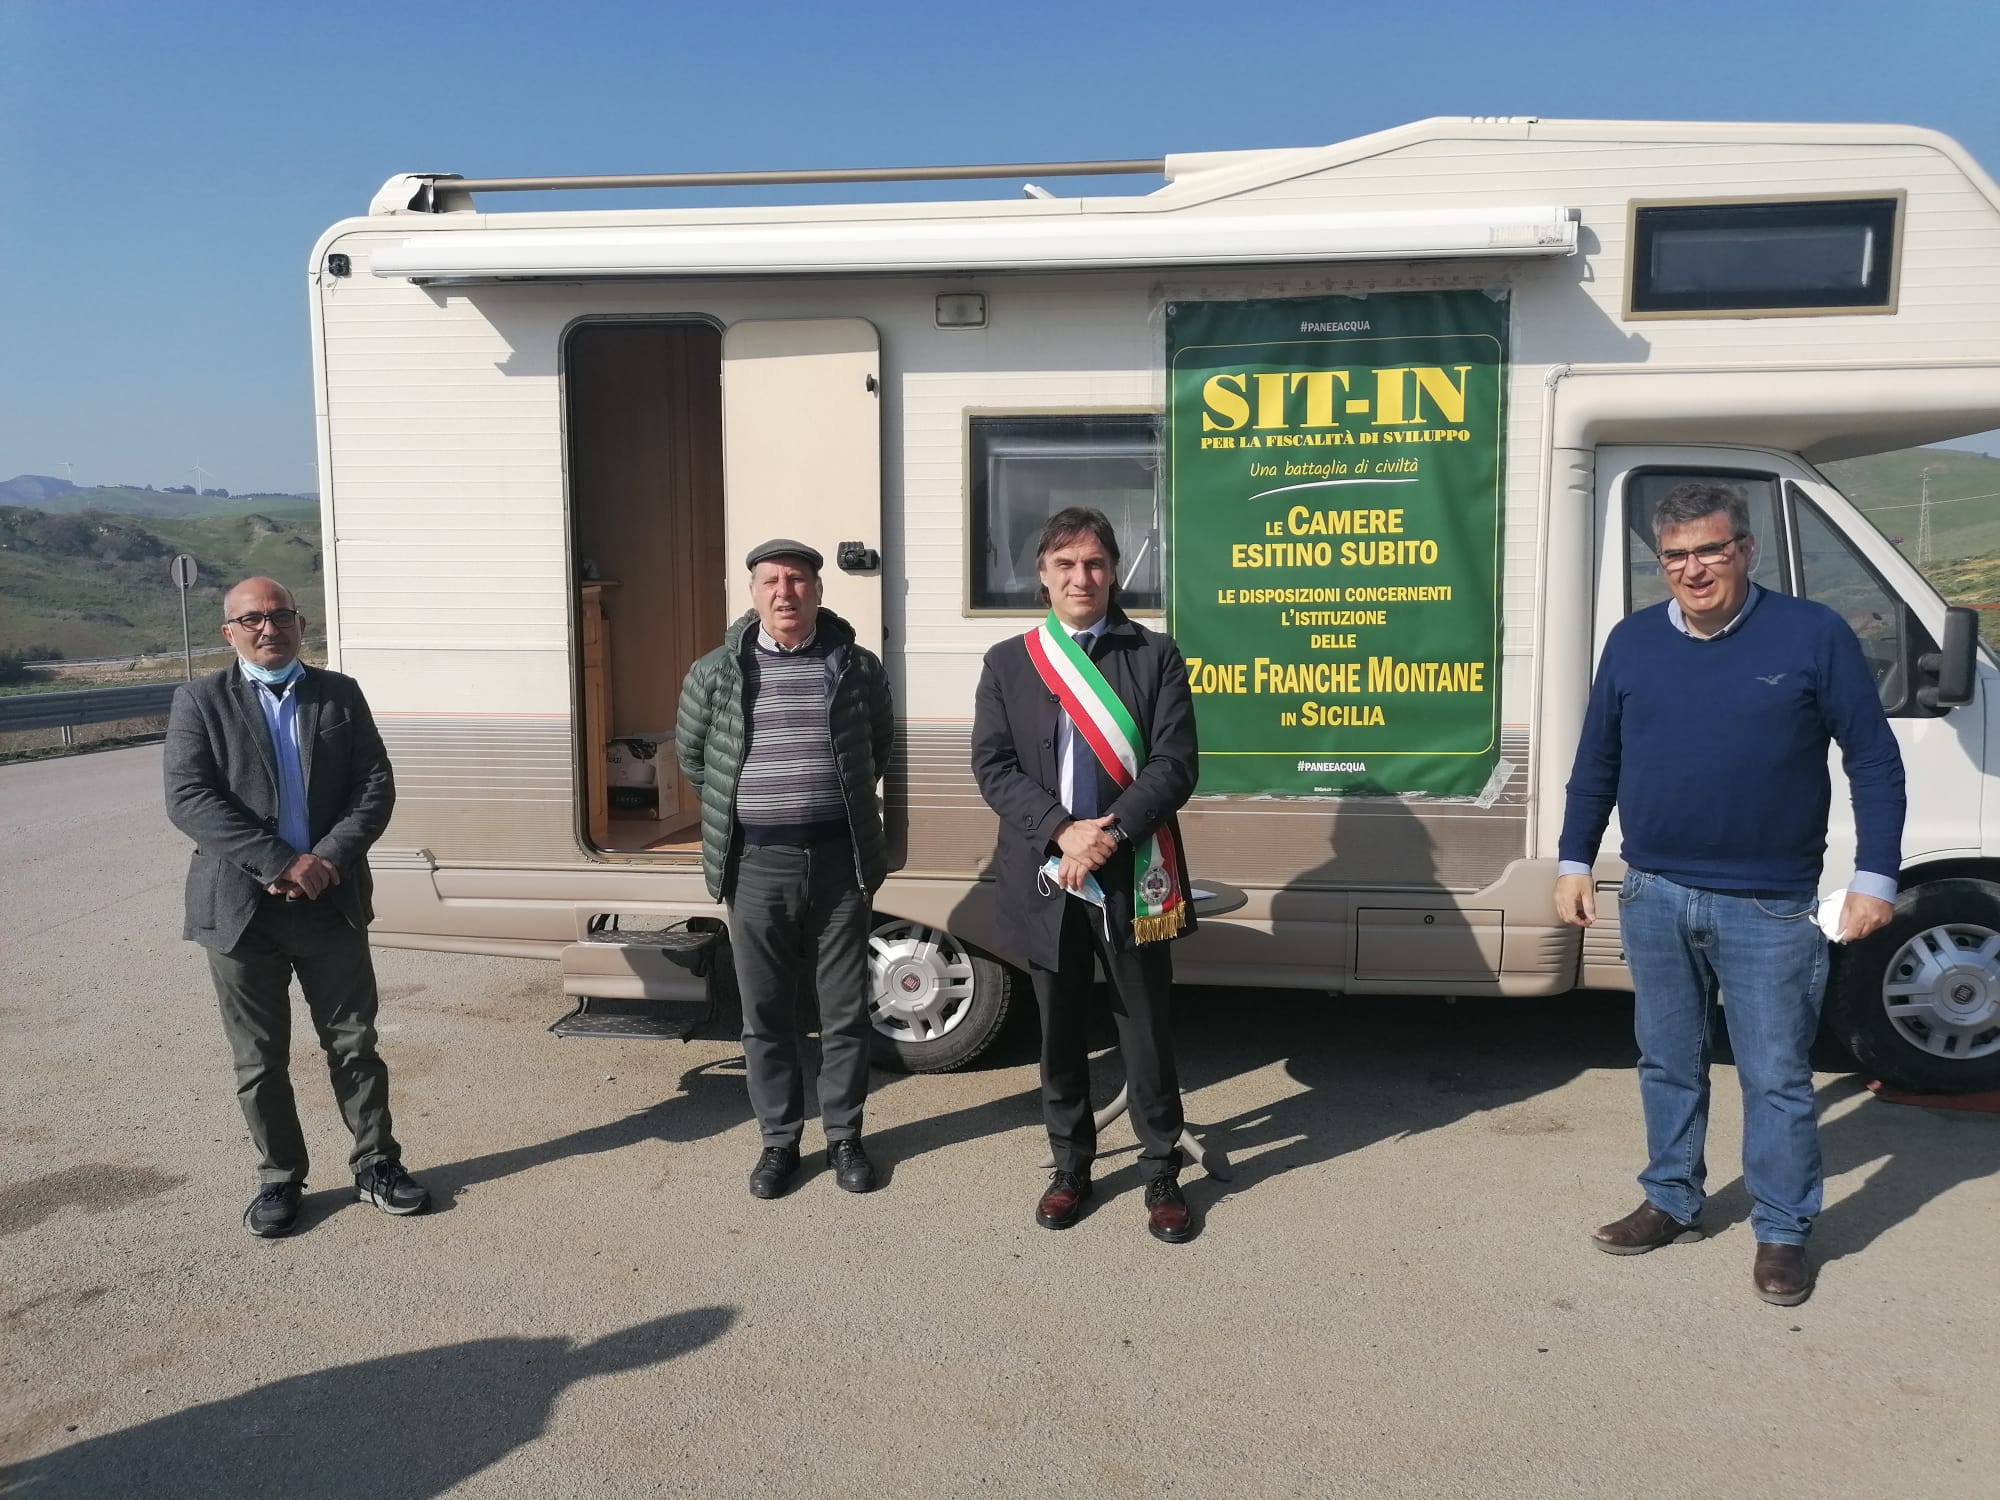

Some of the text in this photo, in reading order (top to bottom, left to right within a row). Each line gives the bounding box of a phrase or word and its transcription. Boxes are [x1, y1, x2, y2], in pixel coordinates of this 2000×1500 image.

[1300, 320, 1370, 333] #PANEEACQUA
[1202, 366, 1472, 432] SIT-IN
[1201, 429, 1471, 449] PER LA FISCALITÀ DI SVILUPPO
[1250, 457, 1419, 479] Una battaglia di civiltà
[1265, 505, 1404, 536] LE CAMERE
[1232, 539, 1438, 568] ESITINO SUBITO
[1218, 585, 1452, 604] LE DISPOSIZIONI CONCERNENTI
[1281, 608, 1387, 626] L'ISTITUZIONE
[1310, 633, 1357, 649] DELLE
[1185, 656, 1485, 694] ZONE FRANCHE MONTANE
[1281, 701, 1386, 727] IN SICILIA
[1297, 760, 1366, 773] #PANEEACQUA
